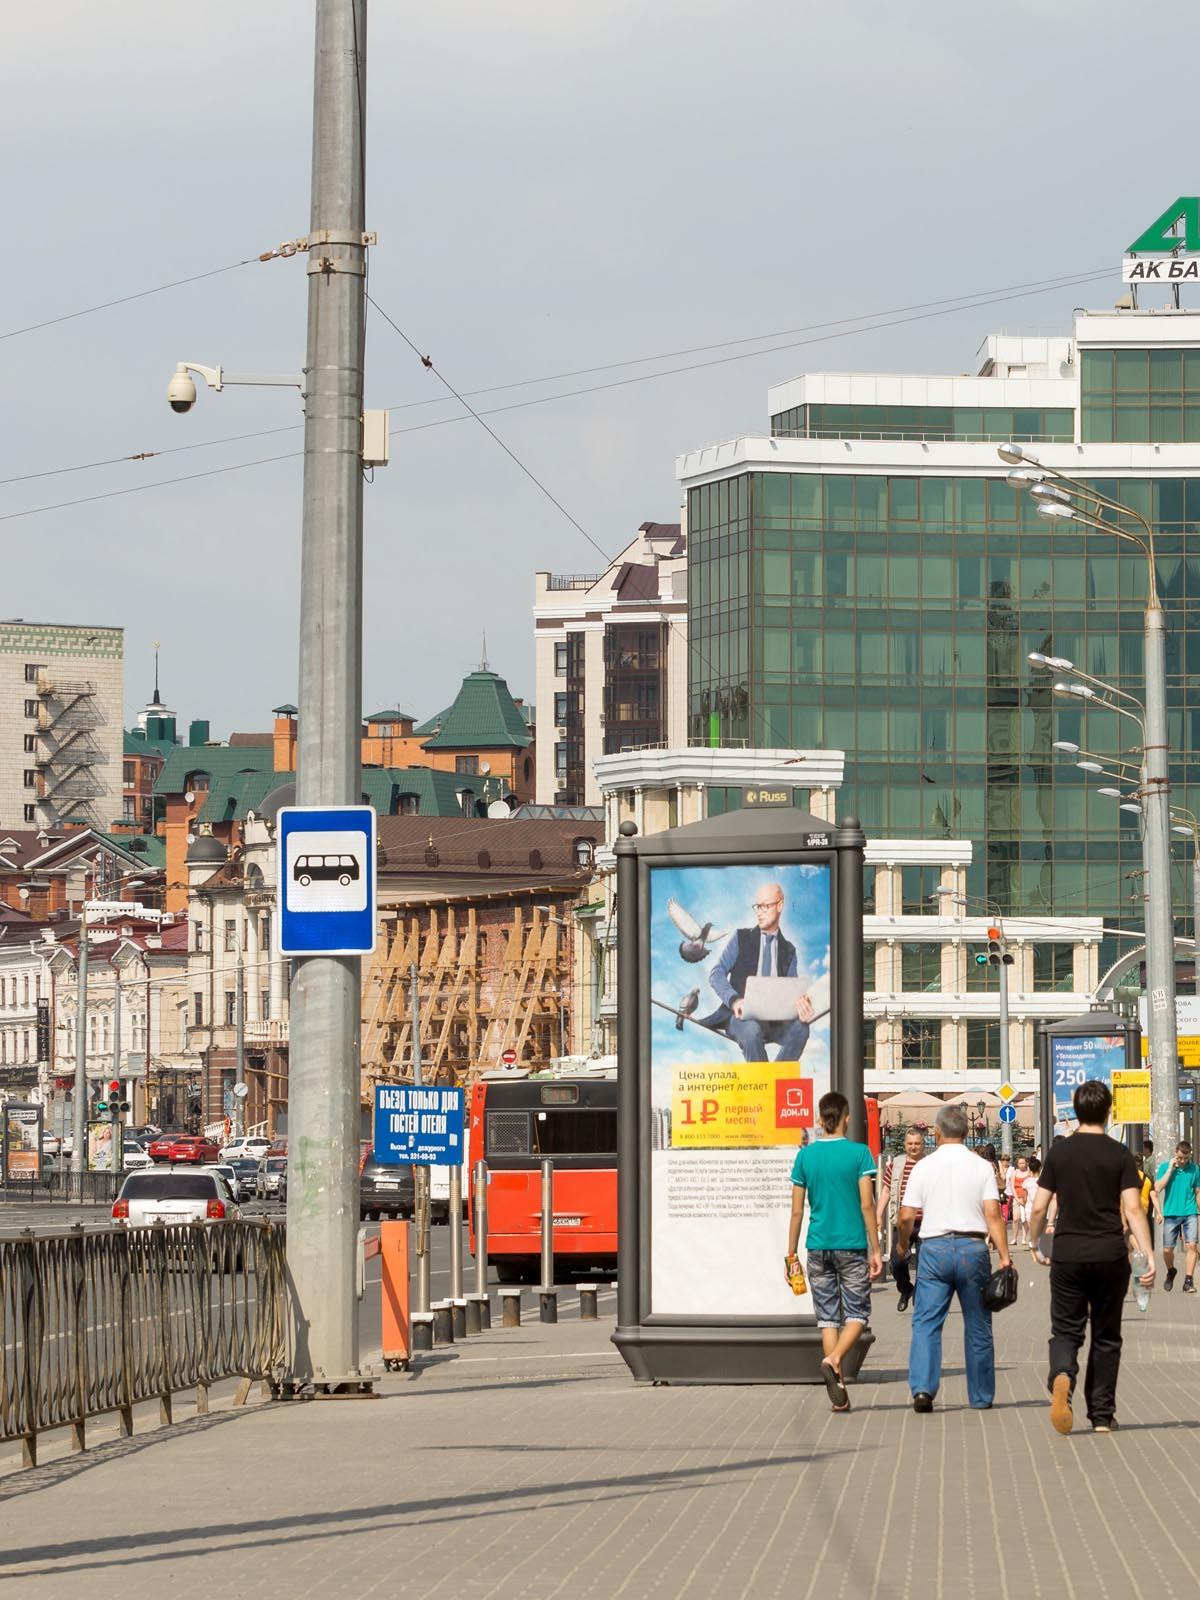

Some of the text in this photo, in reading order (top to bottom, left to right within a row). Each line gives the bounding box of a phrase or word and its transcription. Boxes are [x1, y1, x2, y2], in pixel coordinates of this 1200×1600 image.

[1129, 261, 1164, 278] АК
[759, 791, 787, 802] Russ
[1083, 1041, 1094, 1050] 50
[679, 1071, 740, 1081] Цена упала,
[1055, 1069, 1086, 1086] 250
[679, 1083, 769, 1093] а интернет летает
[380, 1090, 459, 1113] ВЪЕЗД ТОЛЬКО ДЛЯ
[724, 1104, 763, 1115] первый
[390, 1111, 447, 1134] ГОСТЕЙ ОТЕЛЯ
[724, 1116, 757, 1126] месяц
